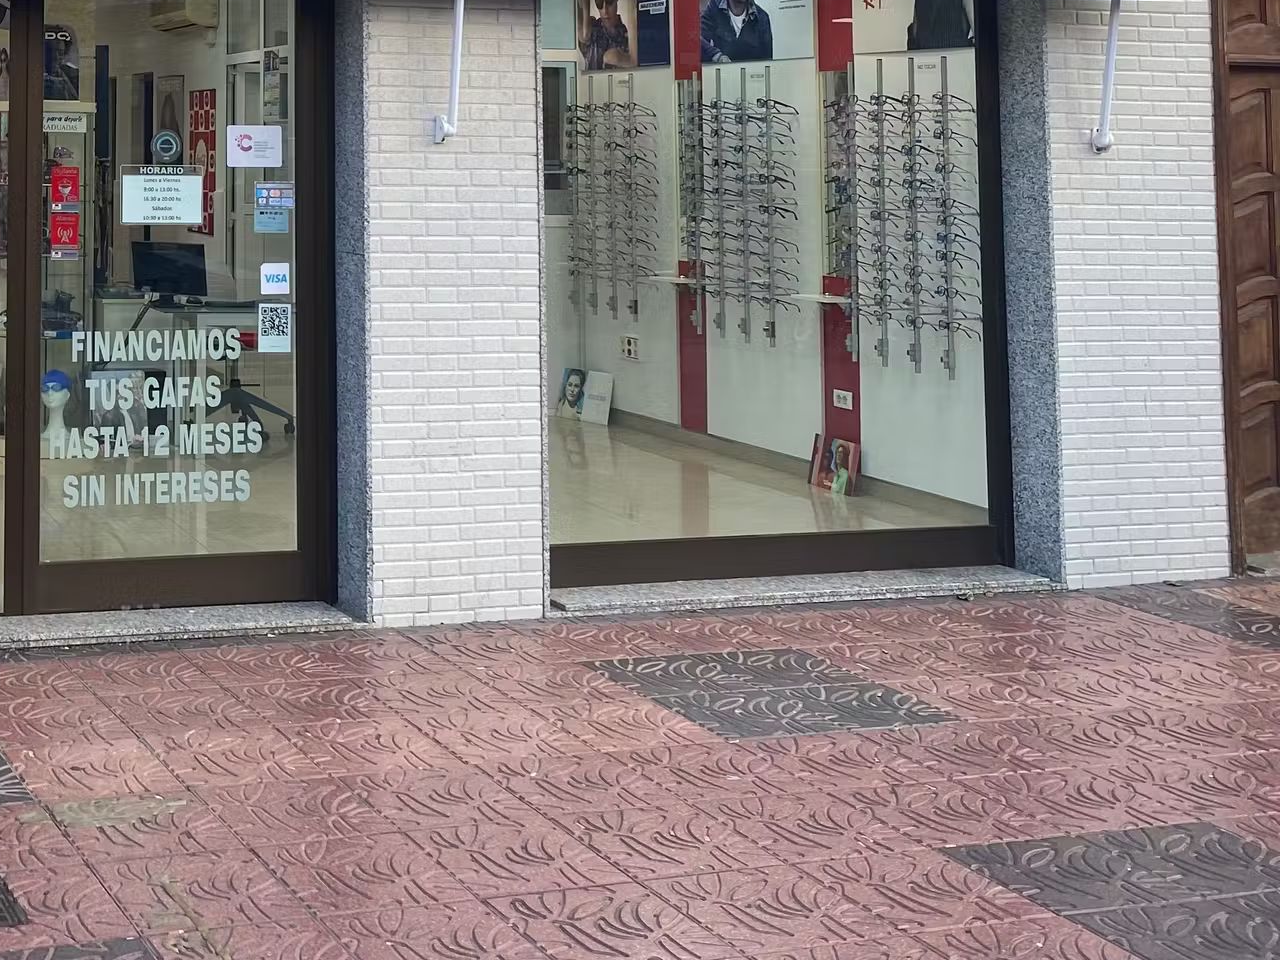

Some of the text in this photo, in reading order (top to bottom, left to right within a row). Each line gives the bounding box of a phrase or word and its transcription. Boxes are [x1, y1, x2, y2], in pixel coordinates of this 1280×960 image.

[139, 166, 184, 175] HORARIO
[264, 273, 288, 283] VISA
[71, 328, 242, 362] FINANCIAMOS
[85, 375, 221, 411] TUS GAFAS
[49, 421, 263, 459] HASTA 12 MESES
[63, 469, 252, 508] SIN INTERESES
